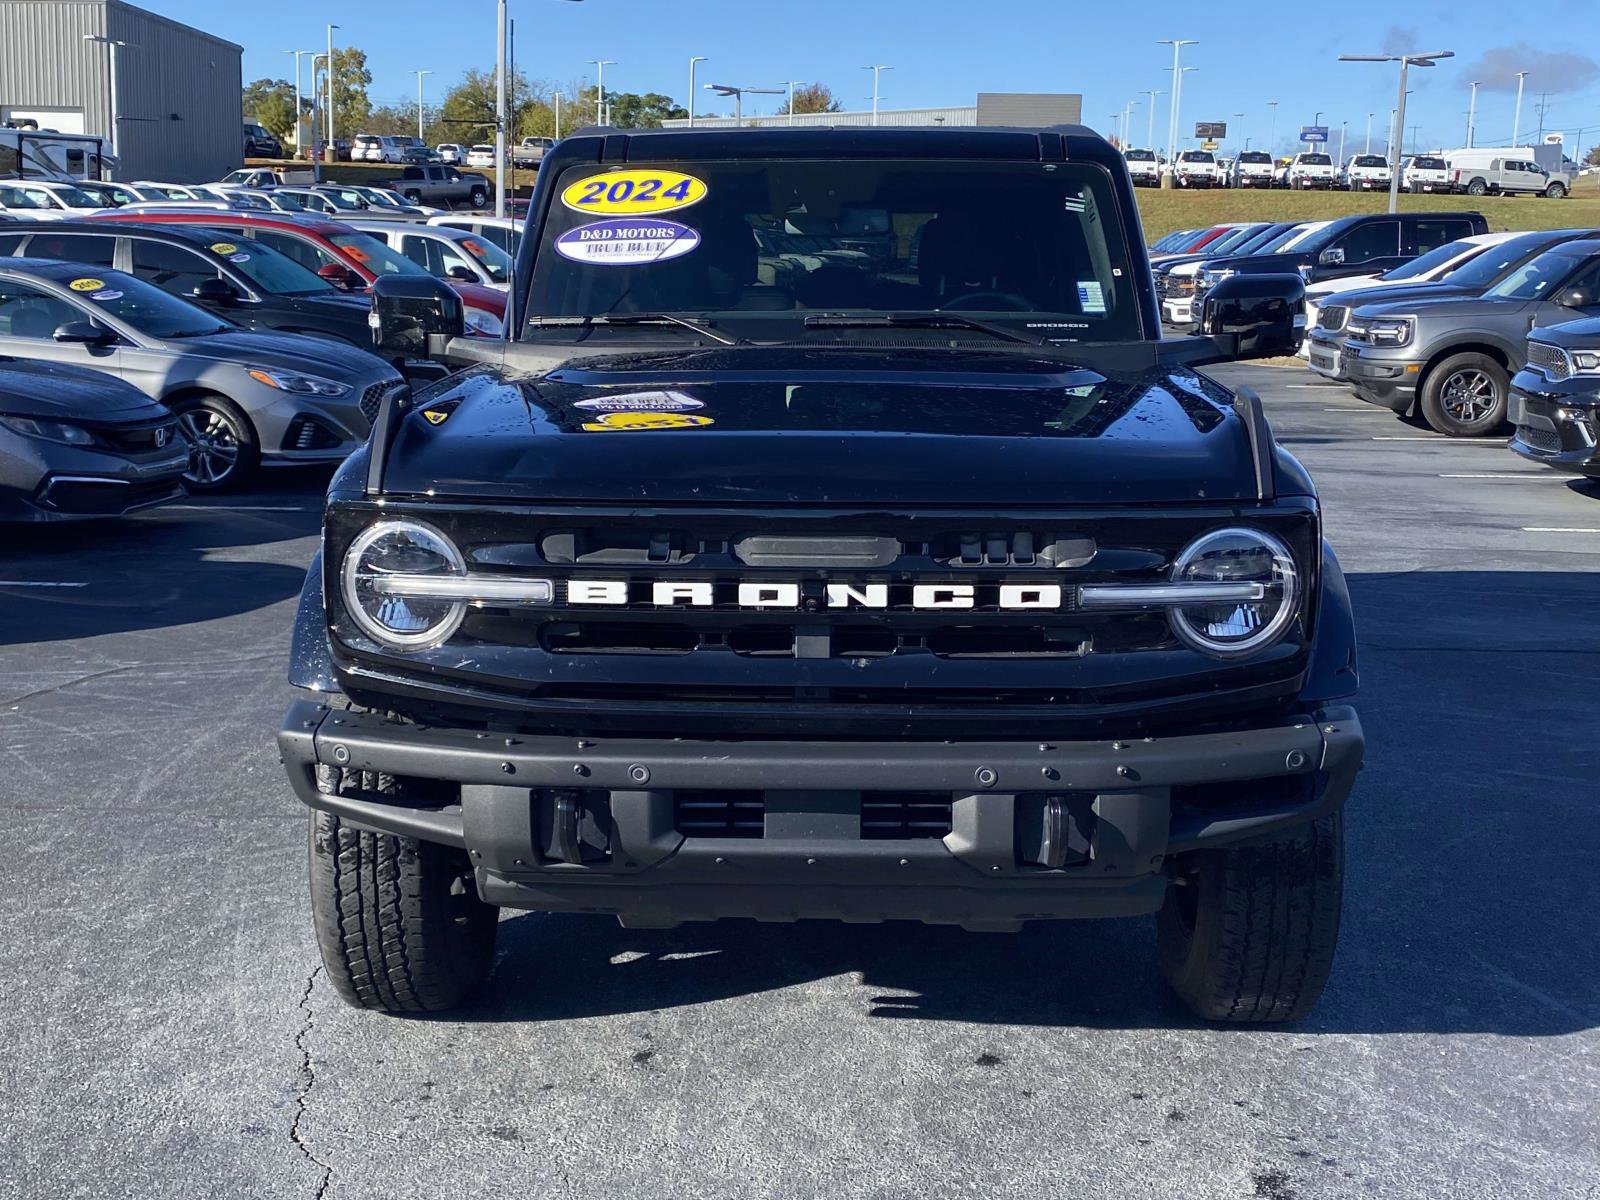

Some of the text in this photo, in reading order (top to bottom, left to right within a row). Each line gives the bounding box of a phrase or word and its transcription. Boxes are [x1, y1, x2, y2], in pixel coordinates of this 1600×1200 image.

[577, 179, 692, 204] 2024
[580, 227, 675, 240] D&D MOTORS
[585, 242, 666, 254] TRUE BLUE
[567, 580, 1062, 608] BRONCO
